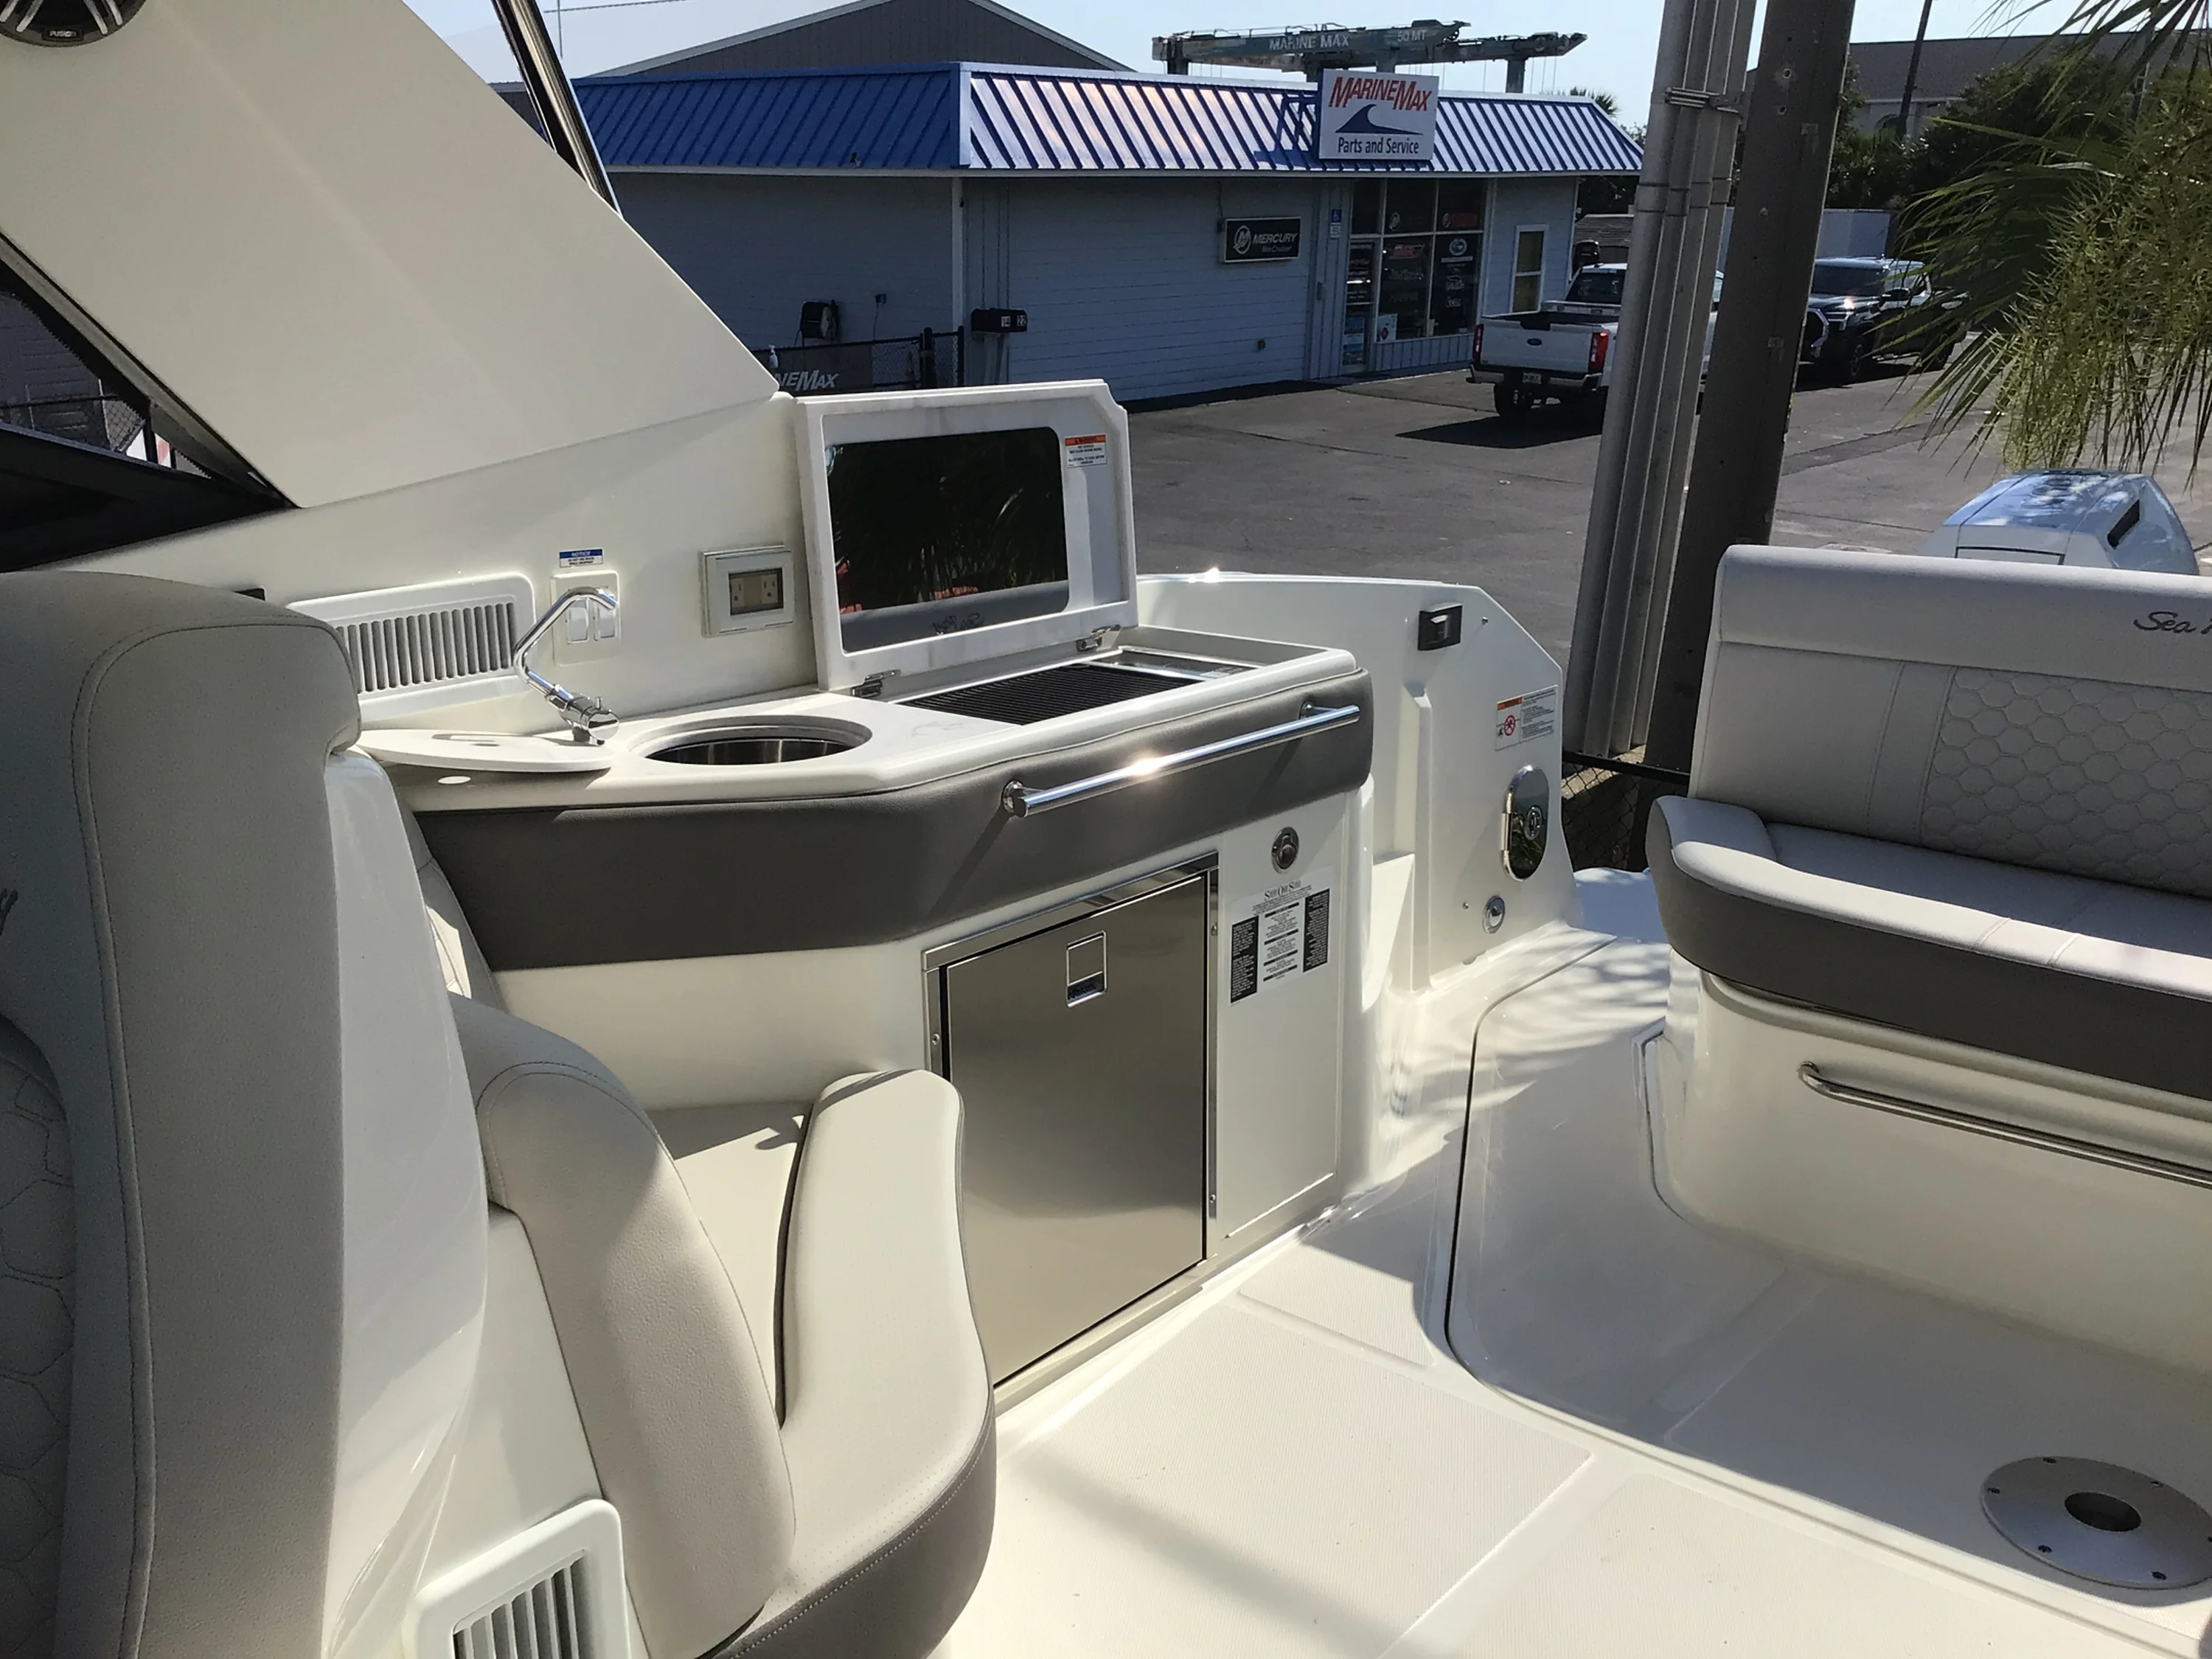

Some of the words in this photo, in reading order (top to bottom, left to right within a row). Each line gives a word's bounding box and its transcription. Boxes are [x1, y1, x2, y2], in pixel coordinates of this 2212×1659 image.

[1269, 35, 1316, 50] MARINE
[1320, 34, 1349, 49] MAX
[1338, 136, 1363, 153] Parts
[1366, 136, 1384, 153] and
[1386, 137, 1419, 154] Service
[1252, 232, 1298, 244] MERCURY
[2133, 611, 2197, 634] Sea
